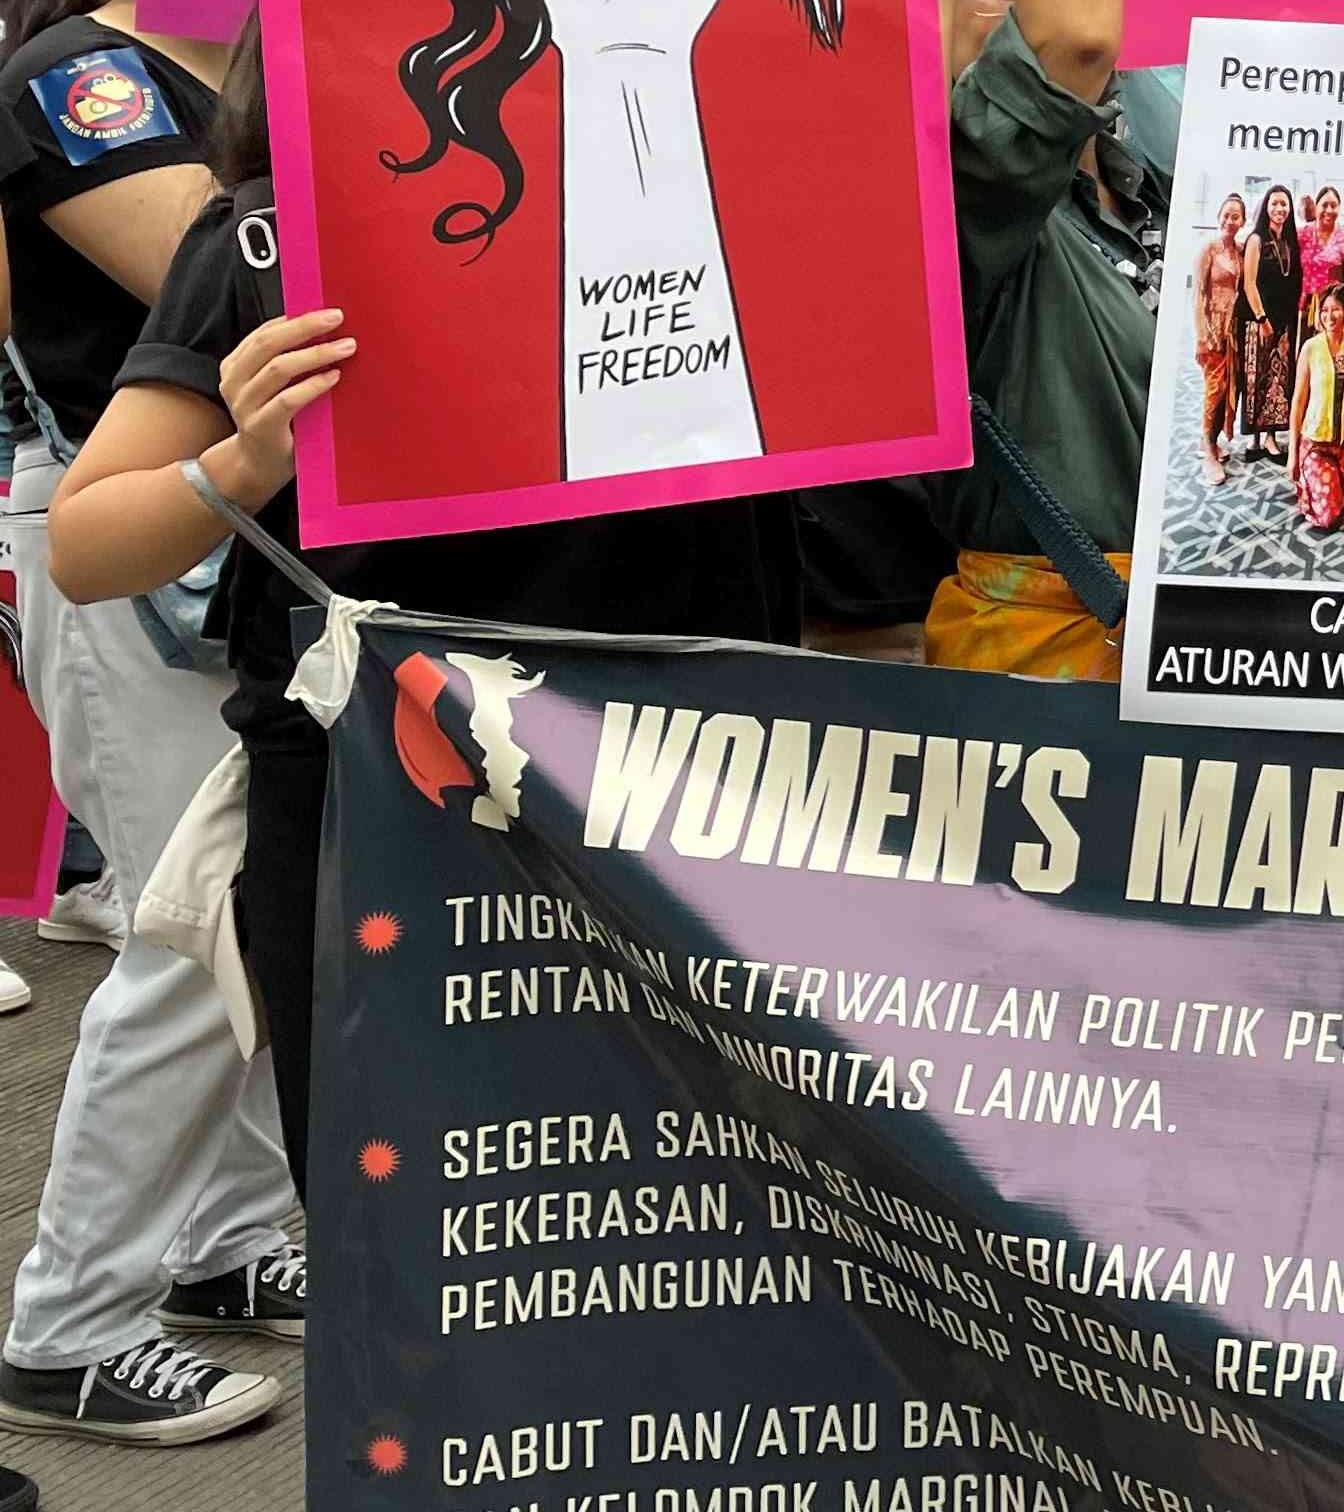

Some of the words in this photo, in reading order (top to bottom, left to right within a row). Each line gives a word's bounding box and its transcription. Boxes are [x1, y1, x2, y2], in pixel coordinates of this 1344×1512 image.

[579, 263, 707, 307] WOMEN
[600, 300, 696, 342] LIFE
[577, 334, 731, 395] FREEDOM
[1154, 645, 1310, 688] ATURAN
[583, 700, 1092, 896] WOMEN'S
[444, 963, 632, 1026] RENTAN
[640, 981, 706, 1045] DAN
[704, 1022, 934, 1113] MINORITAS
[952, 1061, 1179, 1135] LAINNYA.
[687, 955, 1054, 1045] KETERWAKILAN
[1077, 992, 1267, 1058] POLITIK
[441, 1112, 632, 1180] SEGERA
[654, 1109, 812, 1181] SAHKAN
[814, 1159, 968, 1256] SELURUH
[974, 1225, 1237, 1307] KEBIJAKAN
[440, 1182, 745, 1257] KEKERASAN,
[768, 1183, 1015, 1324] DISKRIMINASI,
[1023, 1295, 1193, 1386] STIGMA,
[440, 1255, 812, 1336] PEMBANGUNAN
[832, 1258, 1012, 1363] TERHADAP
[1024, 1341, 1280, 1457] PEREMPUAN.
[441, 1417, 604, 1487] CABUT
[629, 1400, 879, 1465] DAN/ATAU
[902, 1400, 1102, 1493] BATALKAN
